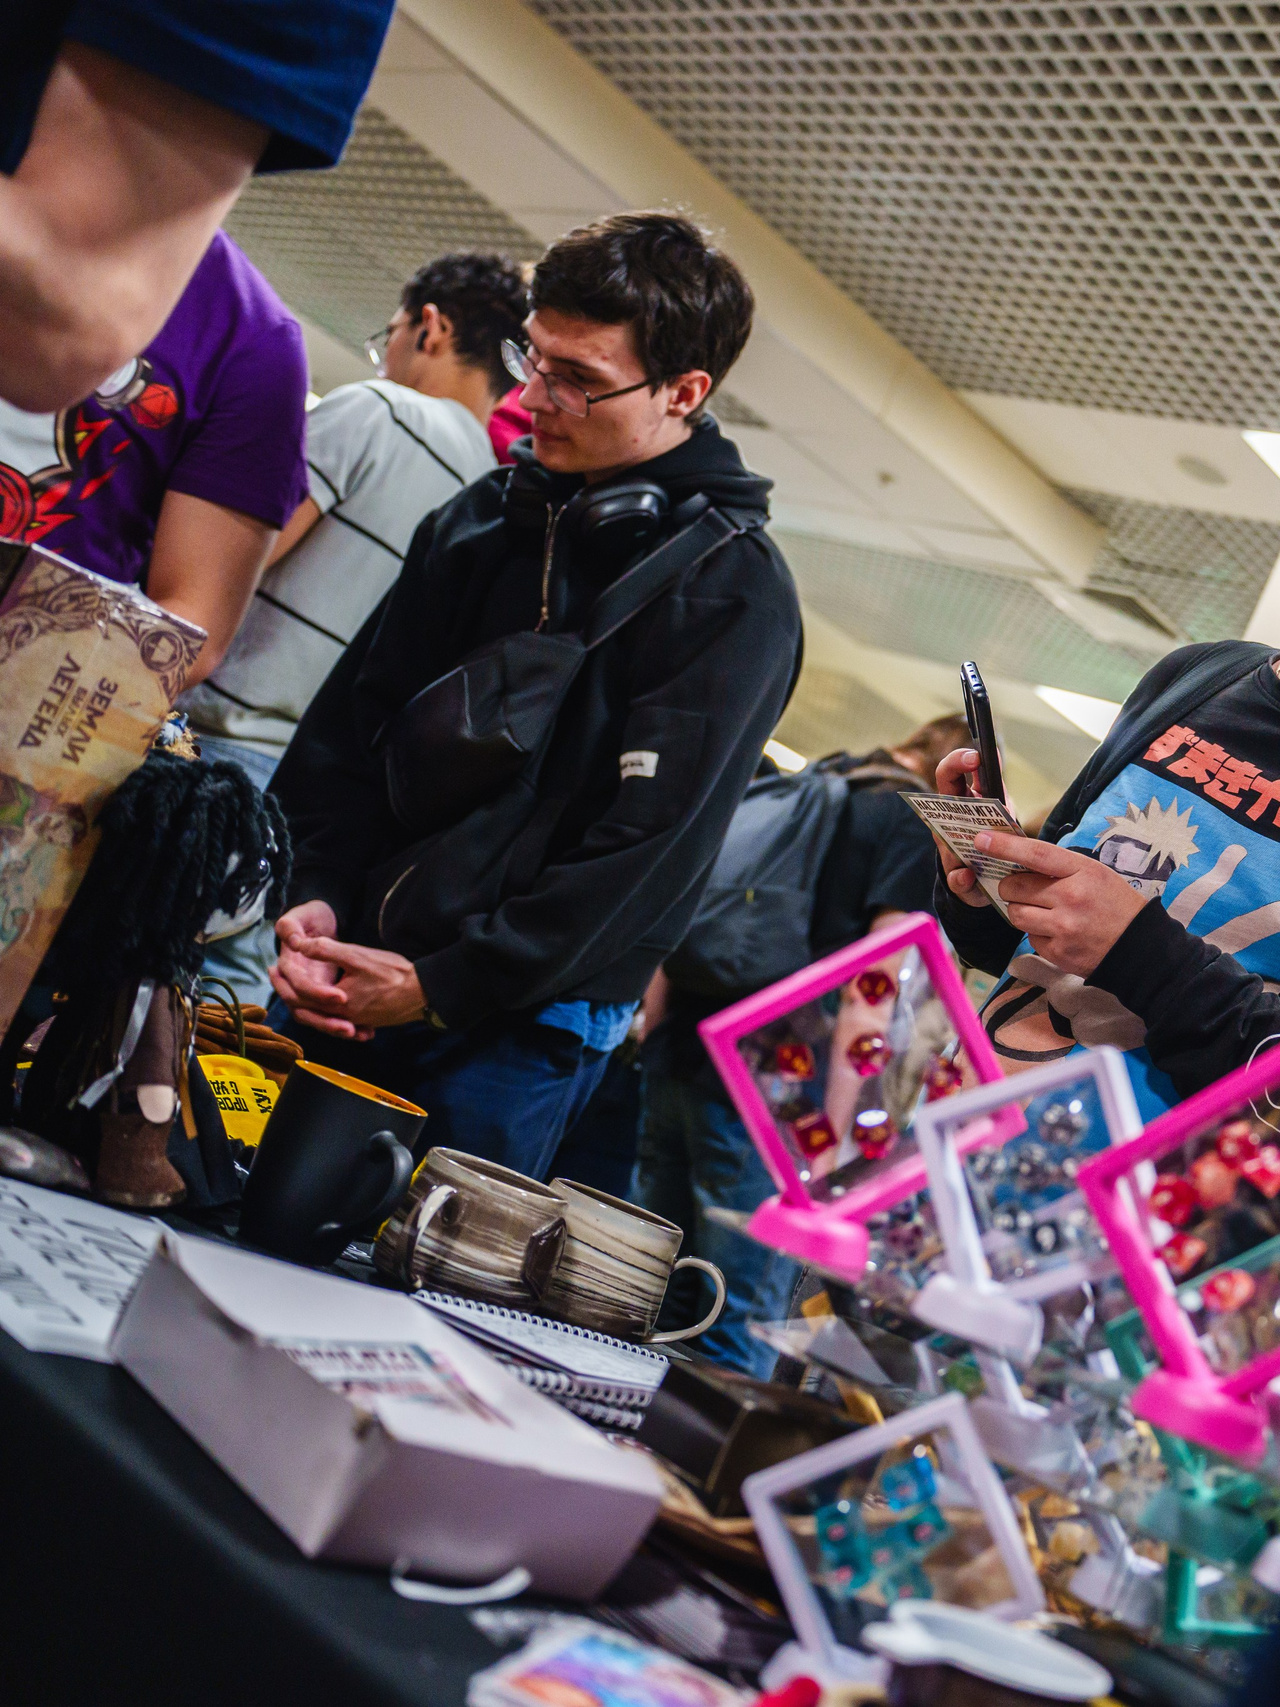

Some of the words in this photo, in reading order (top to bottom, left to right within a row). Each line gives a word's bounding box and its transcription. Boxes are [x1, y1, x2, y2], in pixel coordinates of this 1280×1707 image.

[17, 651, 81, 749] ЛЕГЕНД
[62, 677, 118, 765] ЗЕМЛИ
[913, 799, 975, 816] НАСТОЛЬНАЯ
[972, 804, 1003, 818] ИГРА
[923, 811, 956, 821] ЗЕМЛИ
[971, 817, 1009, 827] ЛЕГЕНД
